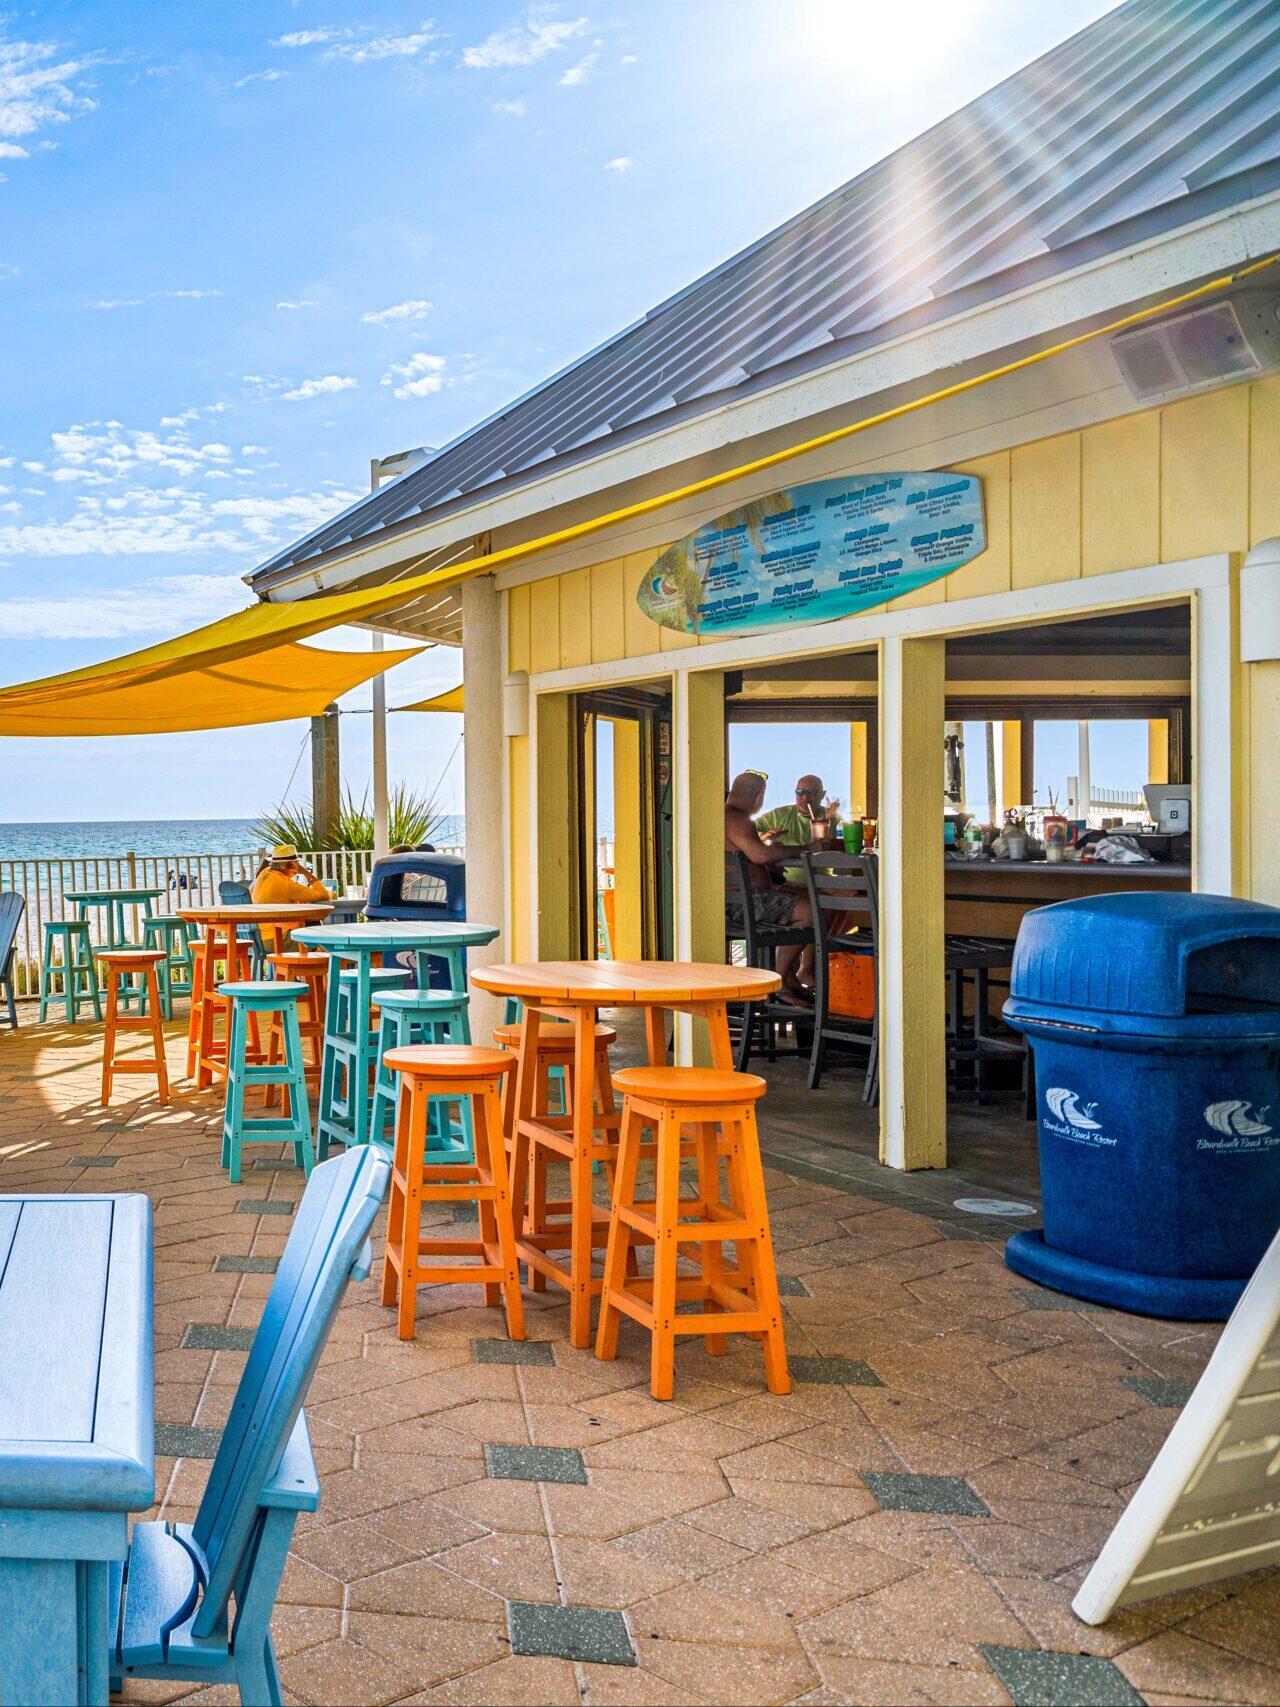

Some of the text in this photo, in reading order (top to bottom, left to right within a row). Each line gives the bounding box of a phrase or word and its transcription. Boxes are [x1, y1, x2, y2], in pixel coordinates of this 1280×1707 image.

[878, 558, 904, 574] Splash
[1070, 1128, 1090, 1140] Beach
[1092, 1133, 1118, 1146] Resort
[1240, 1136, 1261, 1148] Beach
